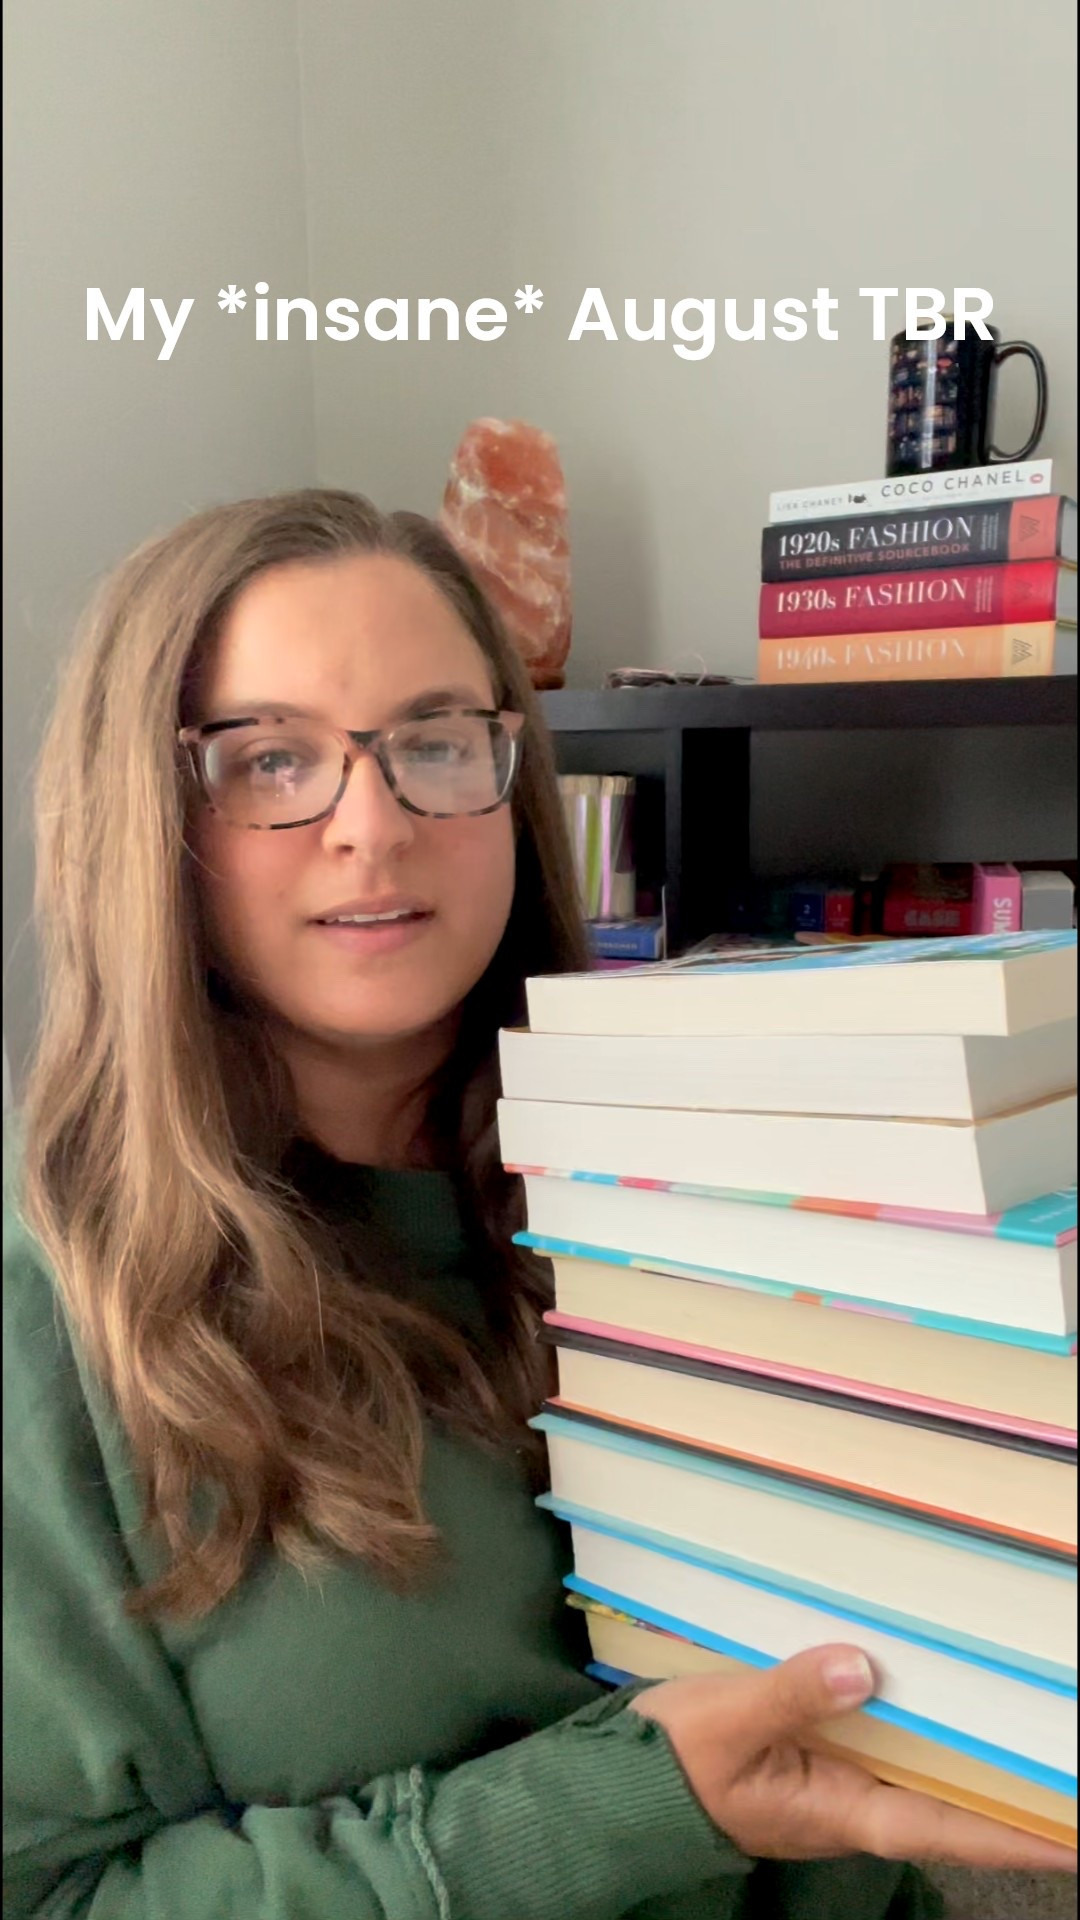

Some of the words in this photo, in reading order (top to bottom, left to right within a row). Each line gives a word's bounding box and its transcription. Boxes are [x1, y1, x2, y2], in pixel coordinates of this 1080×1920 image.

[881, 480, 933, 498] COCO
[944, 469, 1025, 490] CHANEL
[779, 530, 840, 557] 1920s
[848, 515, 975, 550] FASHION
[779, 559, 801, 570] THE
[805, 551, 873, 568] DEFINITIVE
[879, 543, 970, 561] SOURCEBOOK
[777, 587, 837, 613] 1930s
[845, 577, 969, 608] FASHION
[777, 646, 836, 670] 1940s
[845, 638, 966, 665] FASHION
